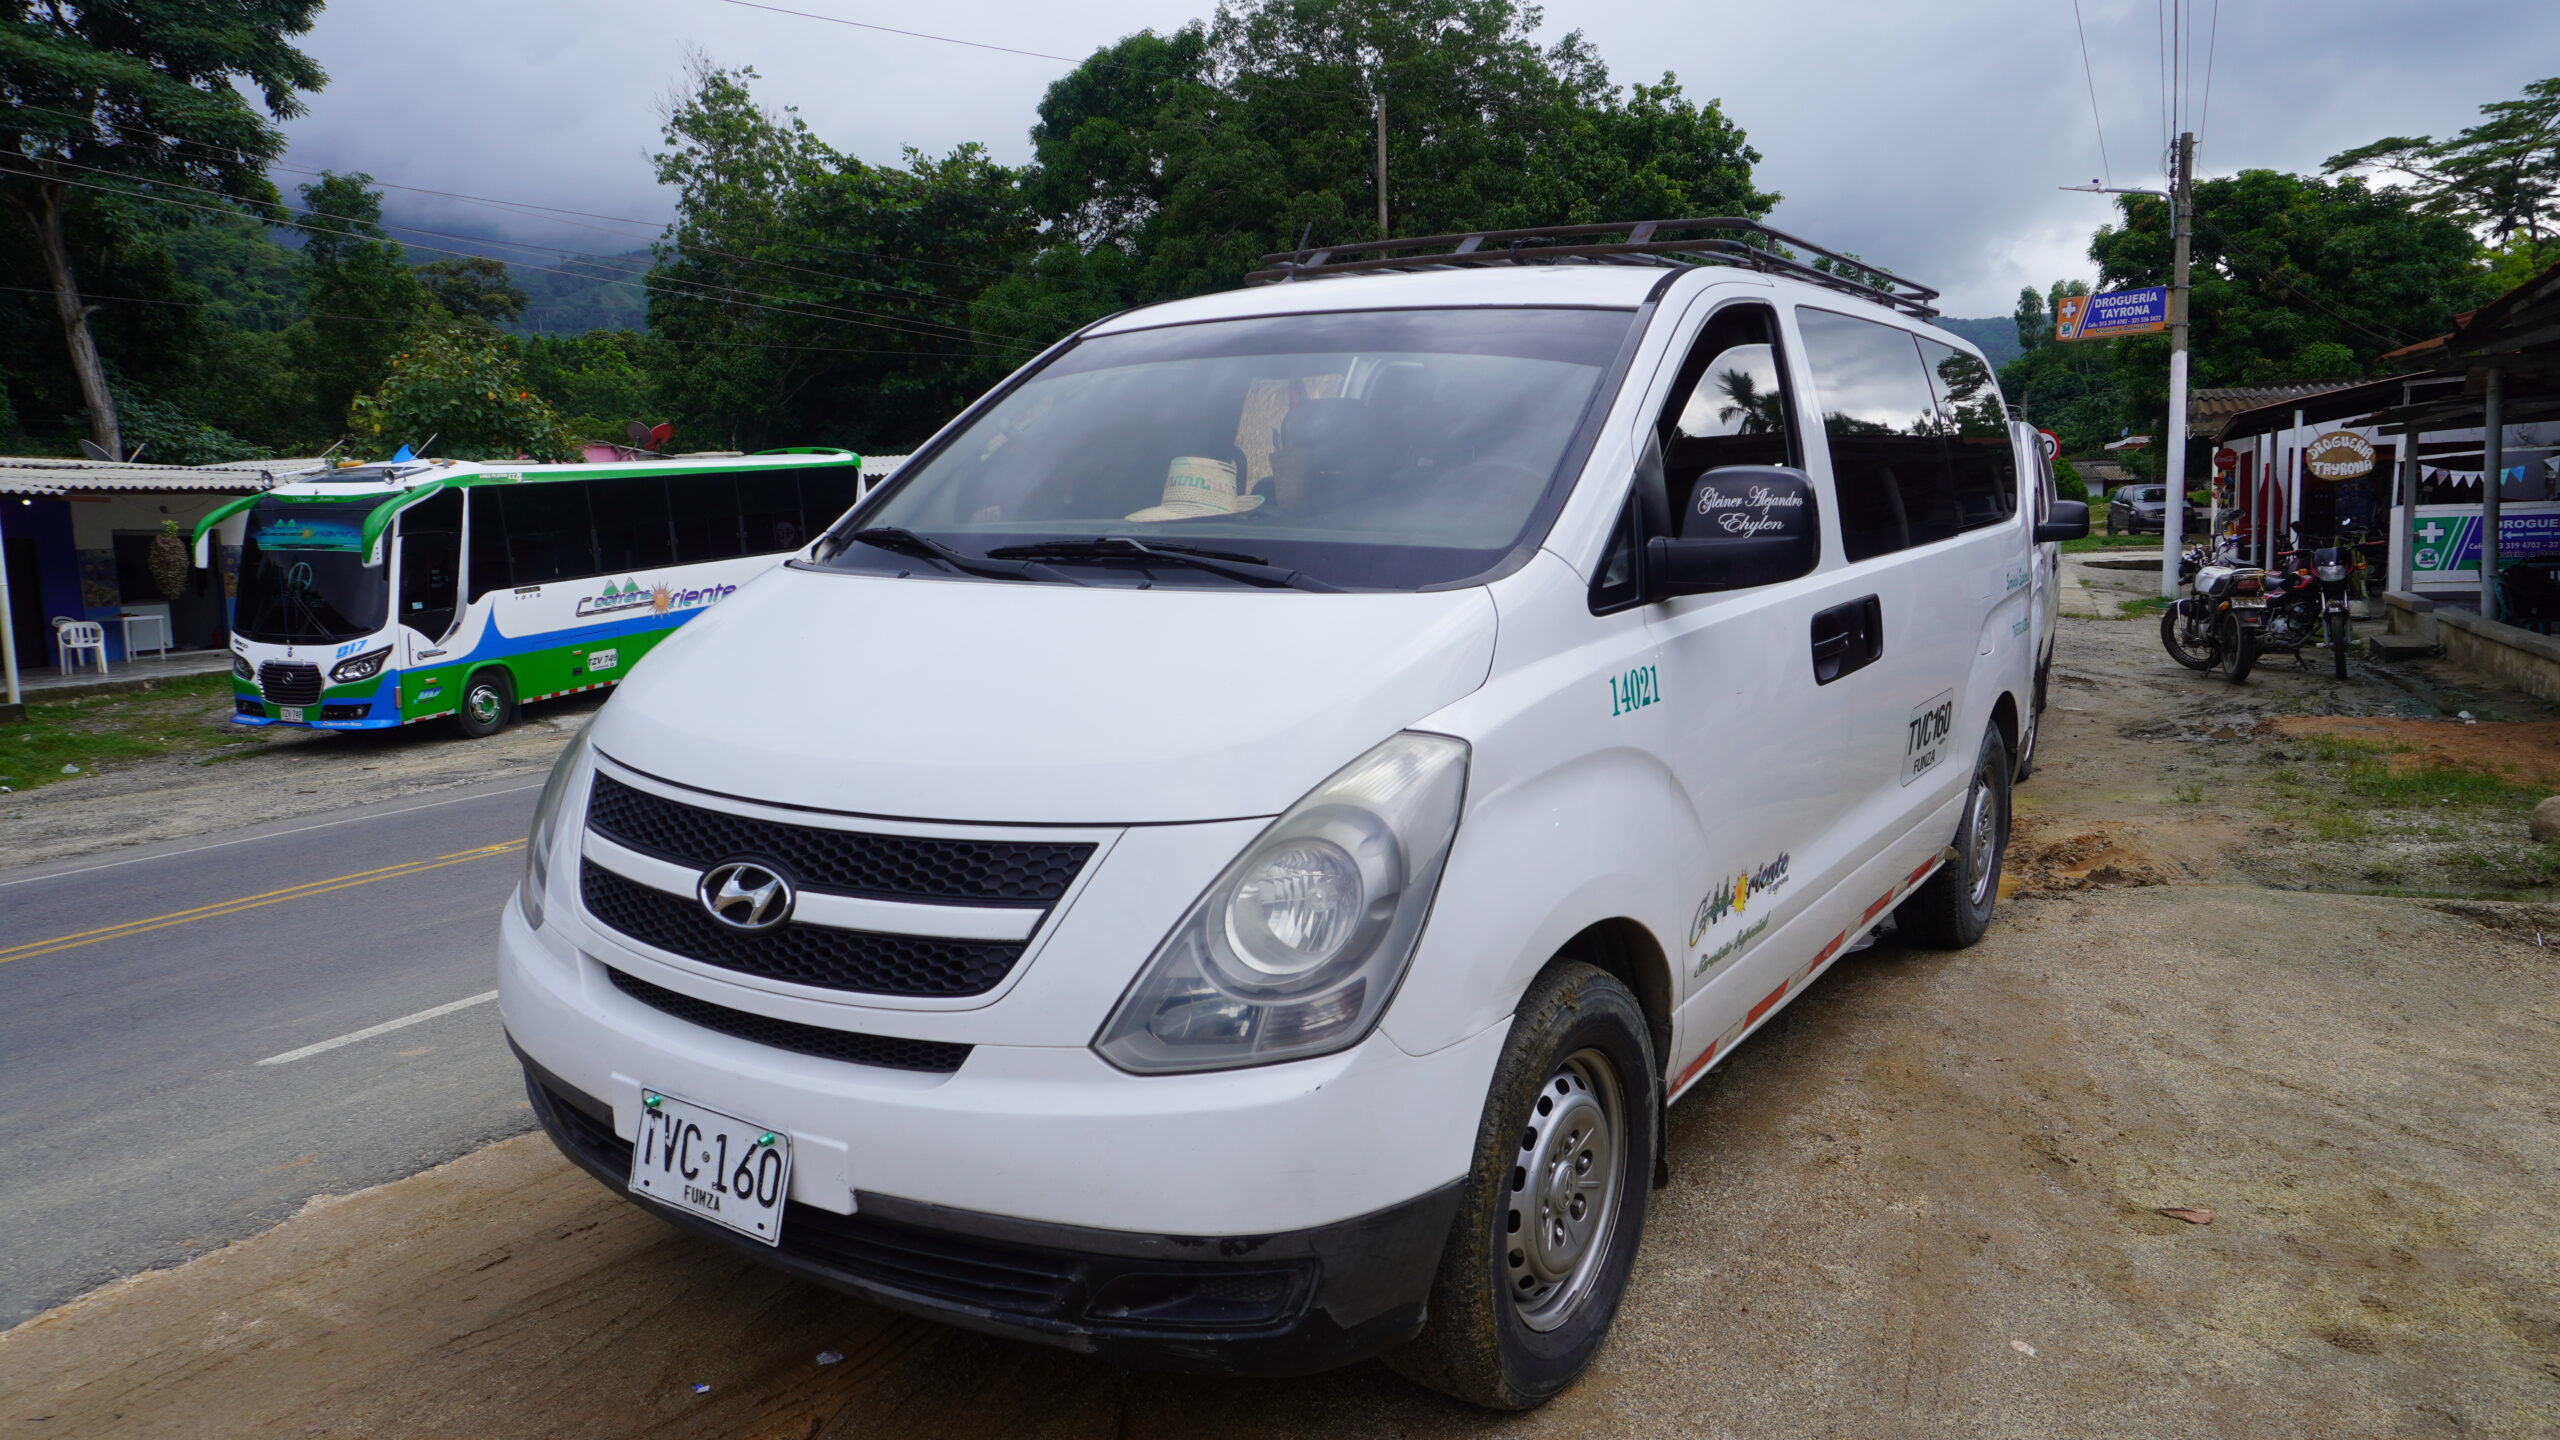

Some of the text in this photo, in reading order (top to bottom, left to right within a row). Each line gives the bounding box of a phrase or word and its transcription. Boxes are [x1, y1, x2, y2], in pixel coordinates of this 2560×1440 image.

[2095, 290, 2157, 308] DROGUERÍA
[2100, 305, 2150, 319] TAYRONA
[2307, 436, 2374, 459] DROGUERIA
[2312, 459, 2373, 476] TAYRONA
[1697, 485, 1804, 515] Gleiner Alejandro
[2522, 541, 2541, 549] 4702
[2548, 541, 2560, 549] 32
[2421, 553, 2436, 561] 24
[1609, 663, 1660, 717] 14021
[1913, 749, 1935, 774] FUNZA
[683, 1184, 721, 1213] FUNZA
